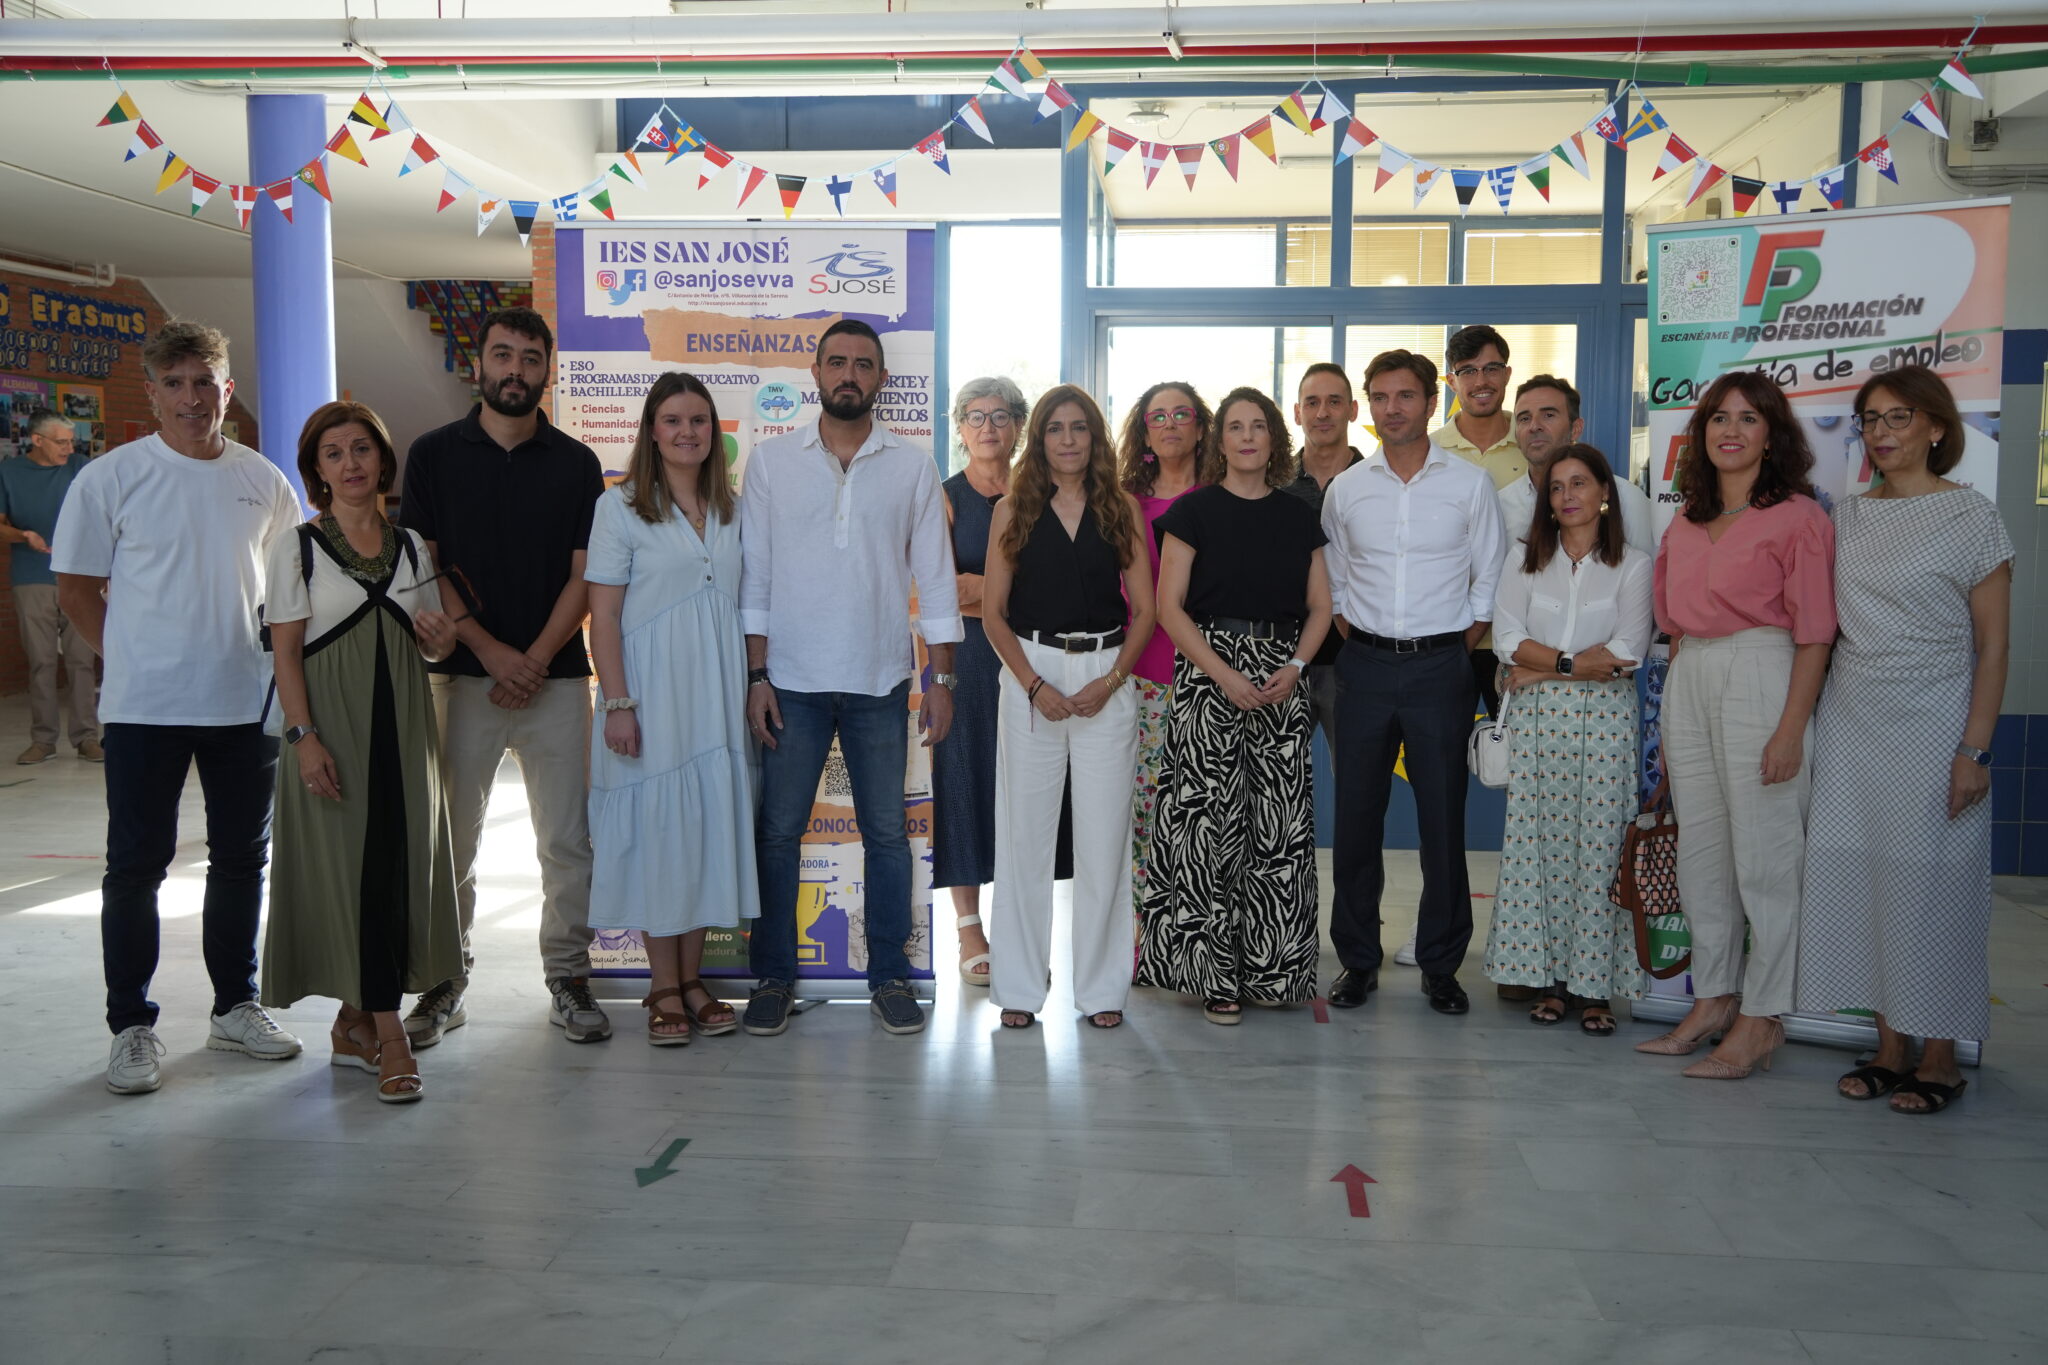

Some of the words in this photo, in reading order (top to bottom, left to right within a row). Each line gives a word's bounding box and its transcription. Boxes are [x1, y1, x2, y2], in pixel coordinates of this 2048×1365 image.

[600, 241, 647, 263] IES
[654, 241, 710, 263] SAN
[717, 236, 789, 263] JOSÉ
[654, 270, 794, 292] @sanjosevva
[1782, 294, 1925, 323] FORMACIÓN
[1661, 329, 1729, 343] ESCANÉAME
[1731, 319, 1887, 343] PROFESIONAL
[686, 329, 818, 353] ENSEÑANZAS
[570, 361, 595, 372] ESO
[1813, 350, 1854, 381] de
[570, 374, 641, 385] PROGRAMAS
[918, 376, 929, 388] Y
[570, 387, 650, 398] BACHILLERA
[581, 404, 625, 414] Ciencias
[581, 419, 639, 429] Humanidad
[763, 425, 784, 435] FPB
[581, 434, 626, 444] Ciencias
[800, 859, 829, 869] ADORA
[589, 954, 620, 970] oaquín
